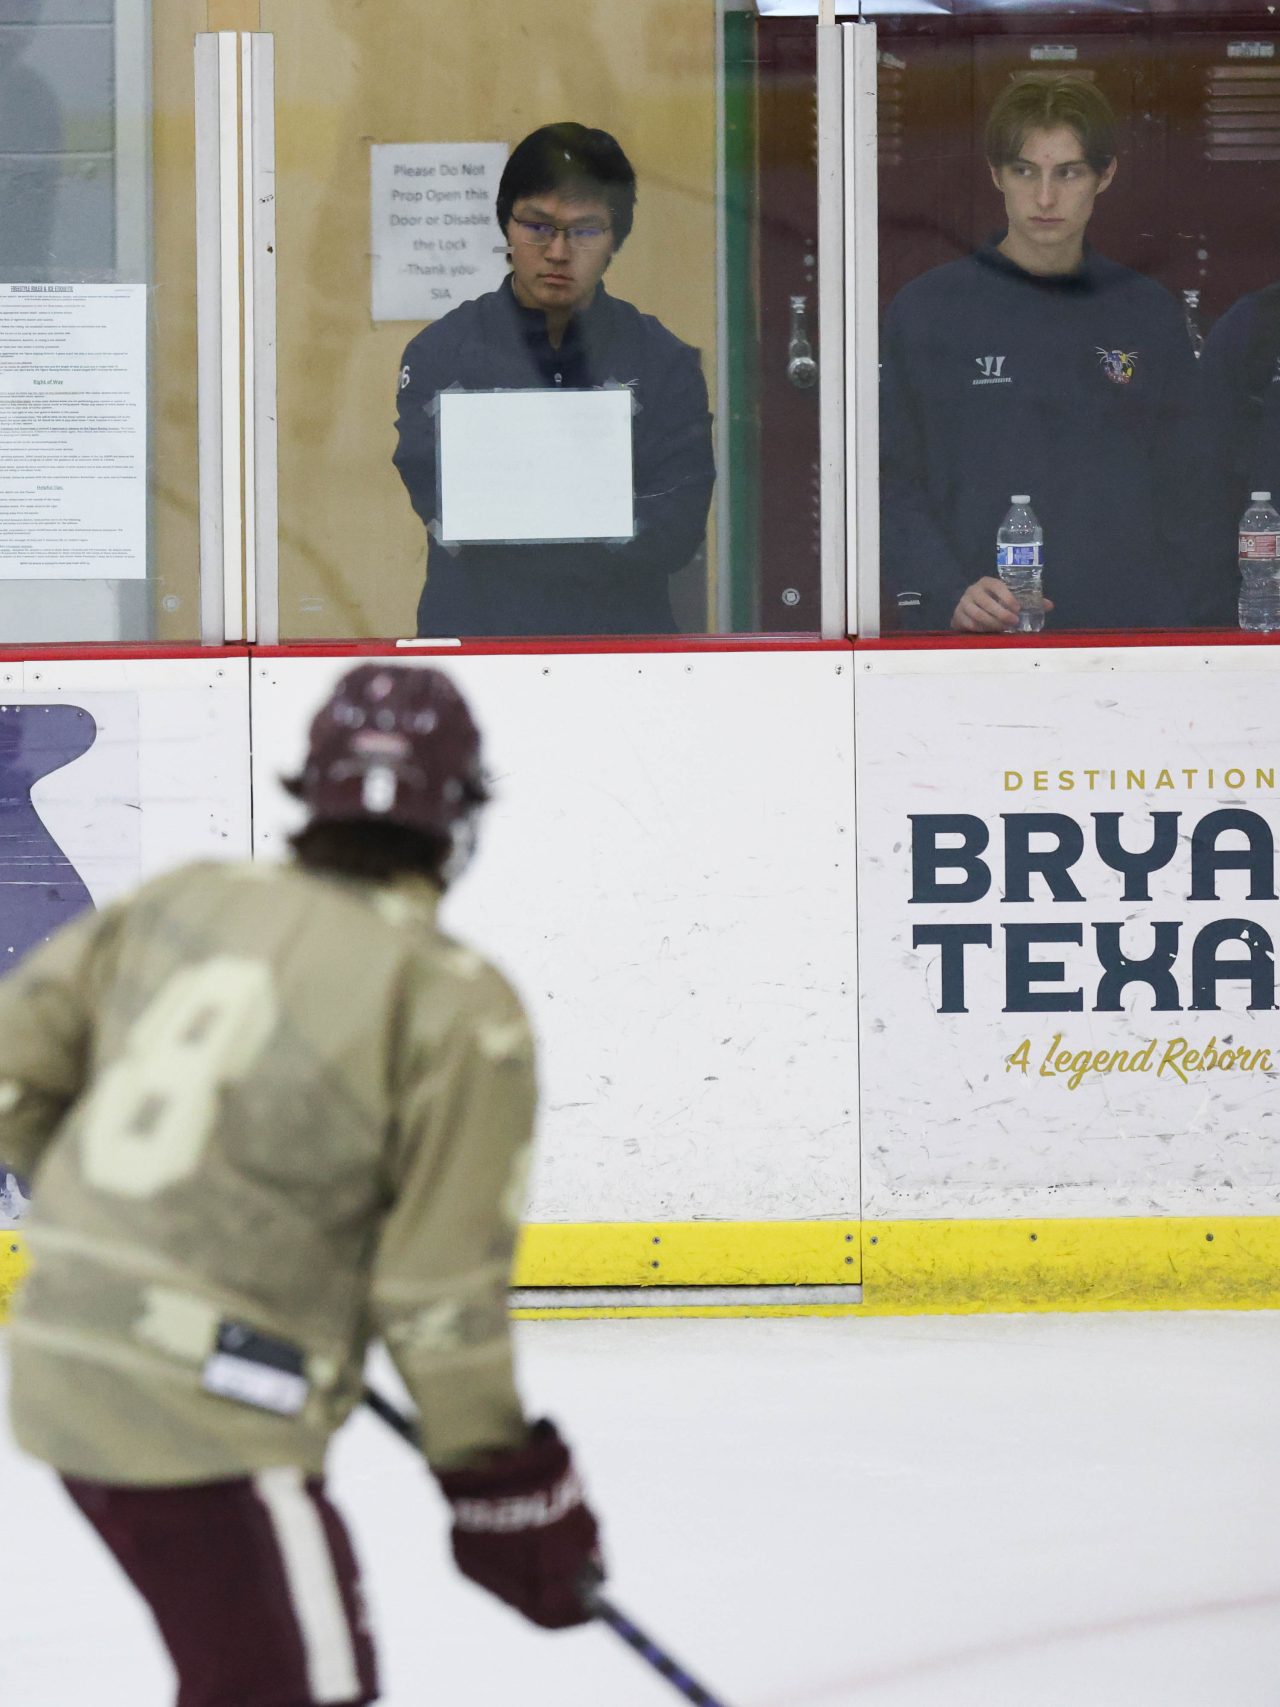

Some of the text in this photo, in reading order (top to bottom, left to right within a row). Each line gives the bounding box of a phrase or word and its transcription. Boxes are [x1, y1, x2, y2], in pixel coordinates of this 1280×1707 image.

[393, 163, 486, 177] Please Do Not
[392, 188, 490, 204] Prop Open this
[390, 213, 492, 227] Door or Disable
[413, 237, 467, 251] the Lock
[430, 288, 452, 300] SIA
[1003, 767, 1276, 792] DESTINATION
[1005, 1033, 1274, 1091] A Legend Reborn
[81, 954, 279, 1199] 8
